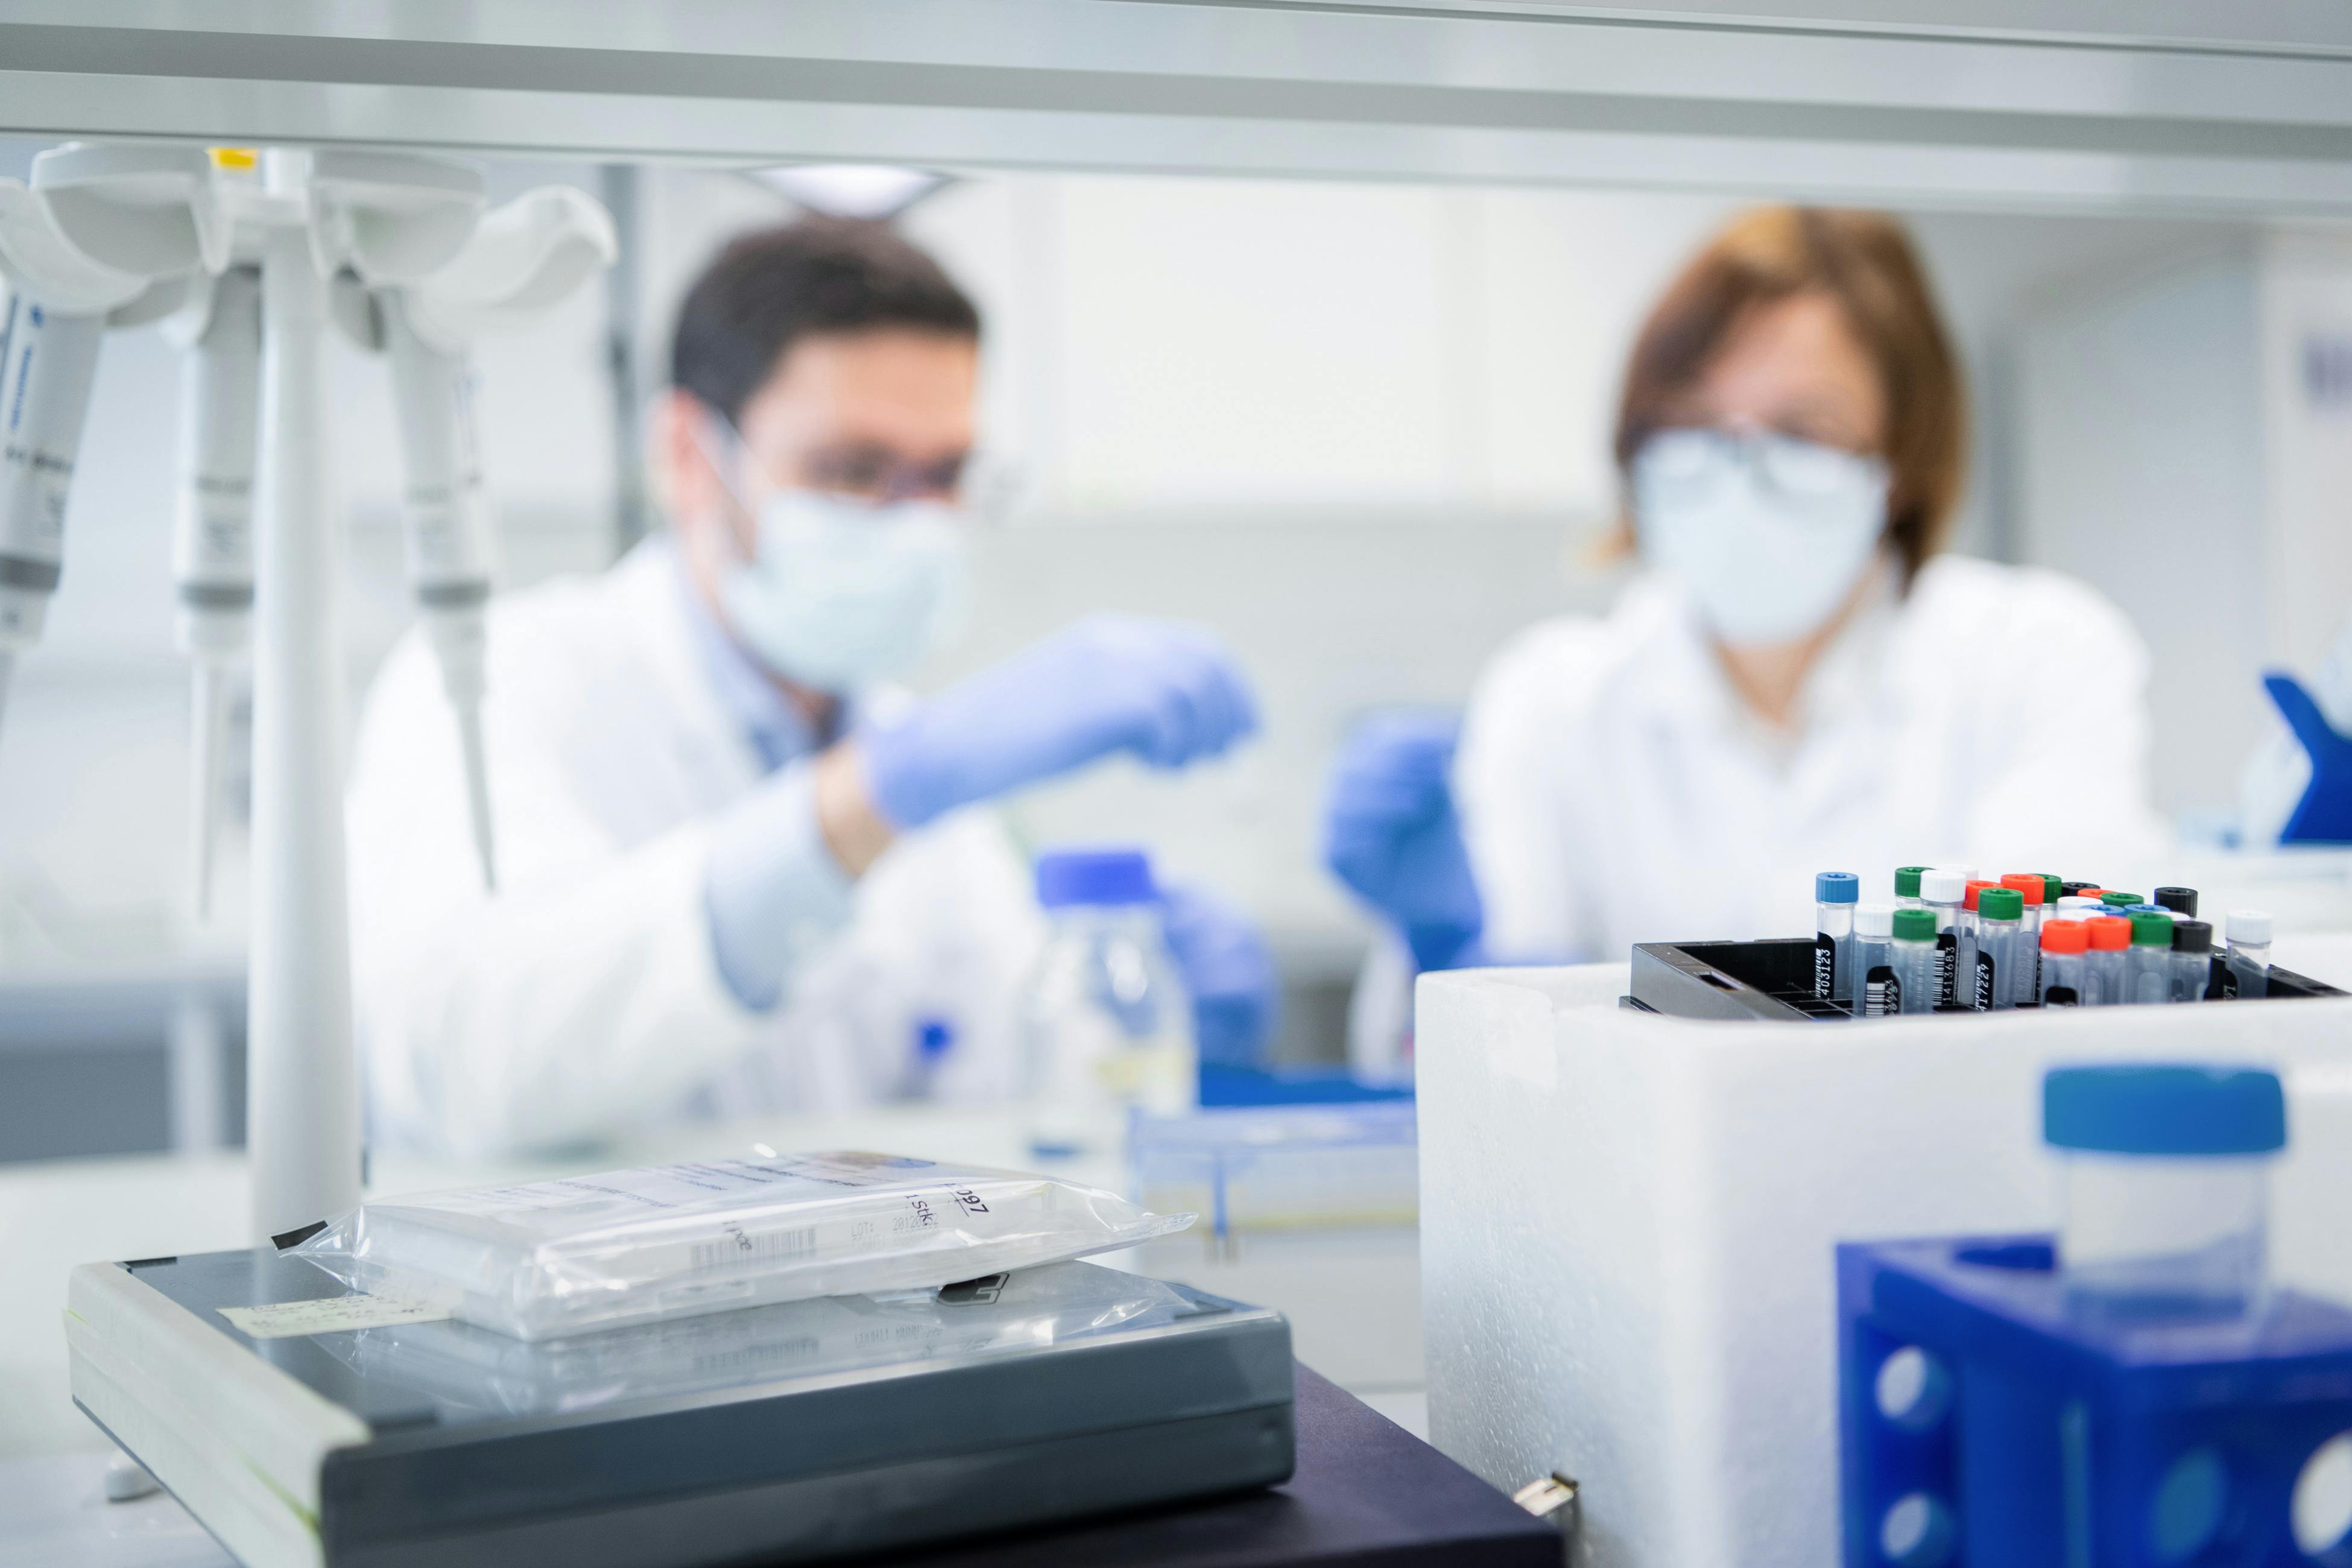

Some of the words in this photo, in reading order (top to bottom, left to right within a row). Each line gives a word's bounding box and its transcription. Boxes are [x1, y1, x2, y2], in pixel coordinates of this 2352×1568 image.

[1820, 949, 1831, 1002] 403123
[1943, 946, 1955, 1002] 1413683
[850, 1222, 874, 1238] LOT:
[911, 1200, 934, 1226] Stk.
